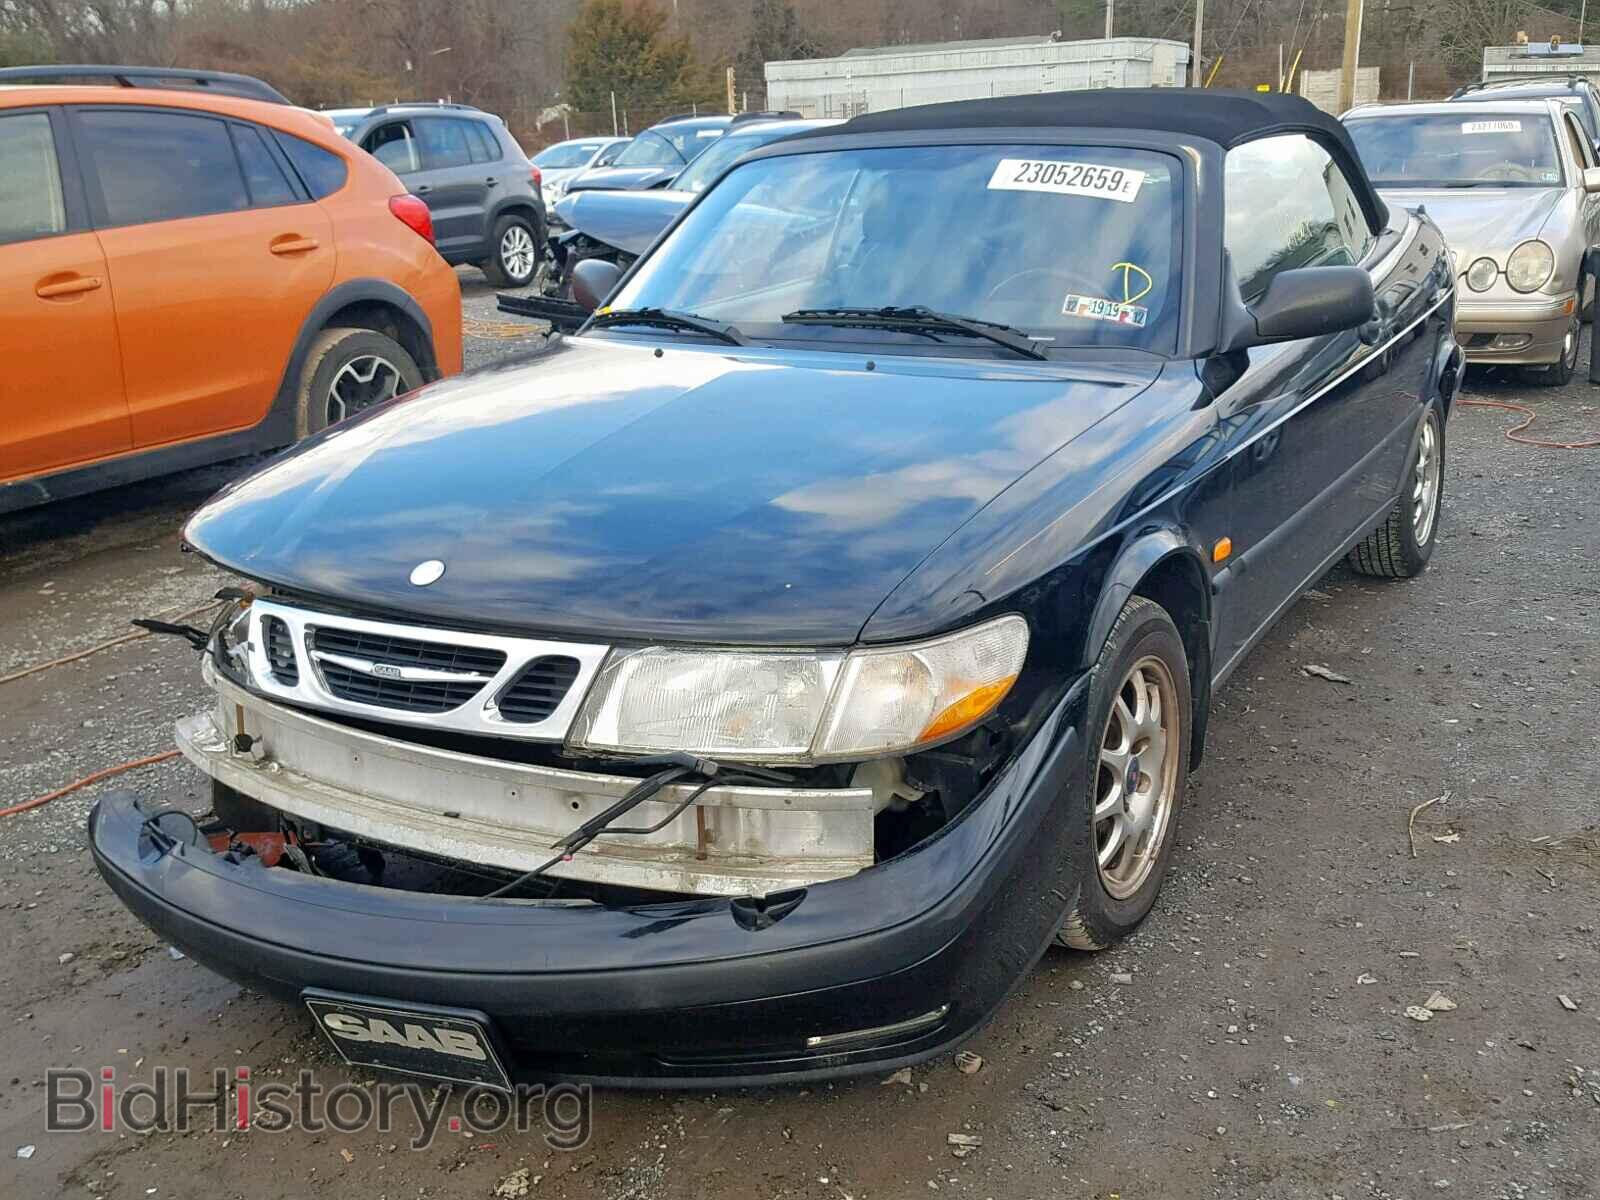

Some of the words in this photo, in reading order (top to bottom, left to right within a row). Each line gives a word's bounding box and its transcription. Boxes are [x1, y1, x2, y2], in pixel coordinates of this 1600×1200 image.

[1013, 162, 1124, 192] 23052659
[1091, 300, 1105, 314] 19
[1107, 303, 1120, 317] 19
[323, 1012, 488, 1061] SAAB
